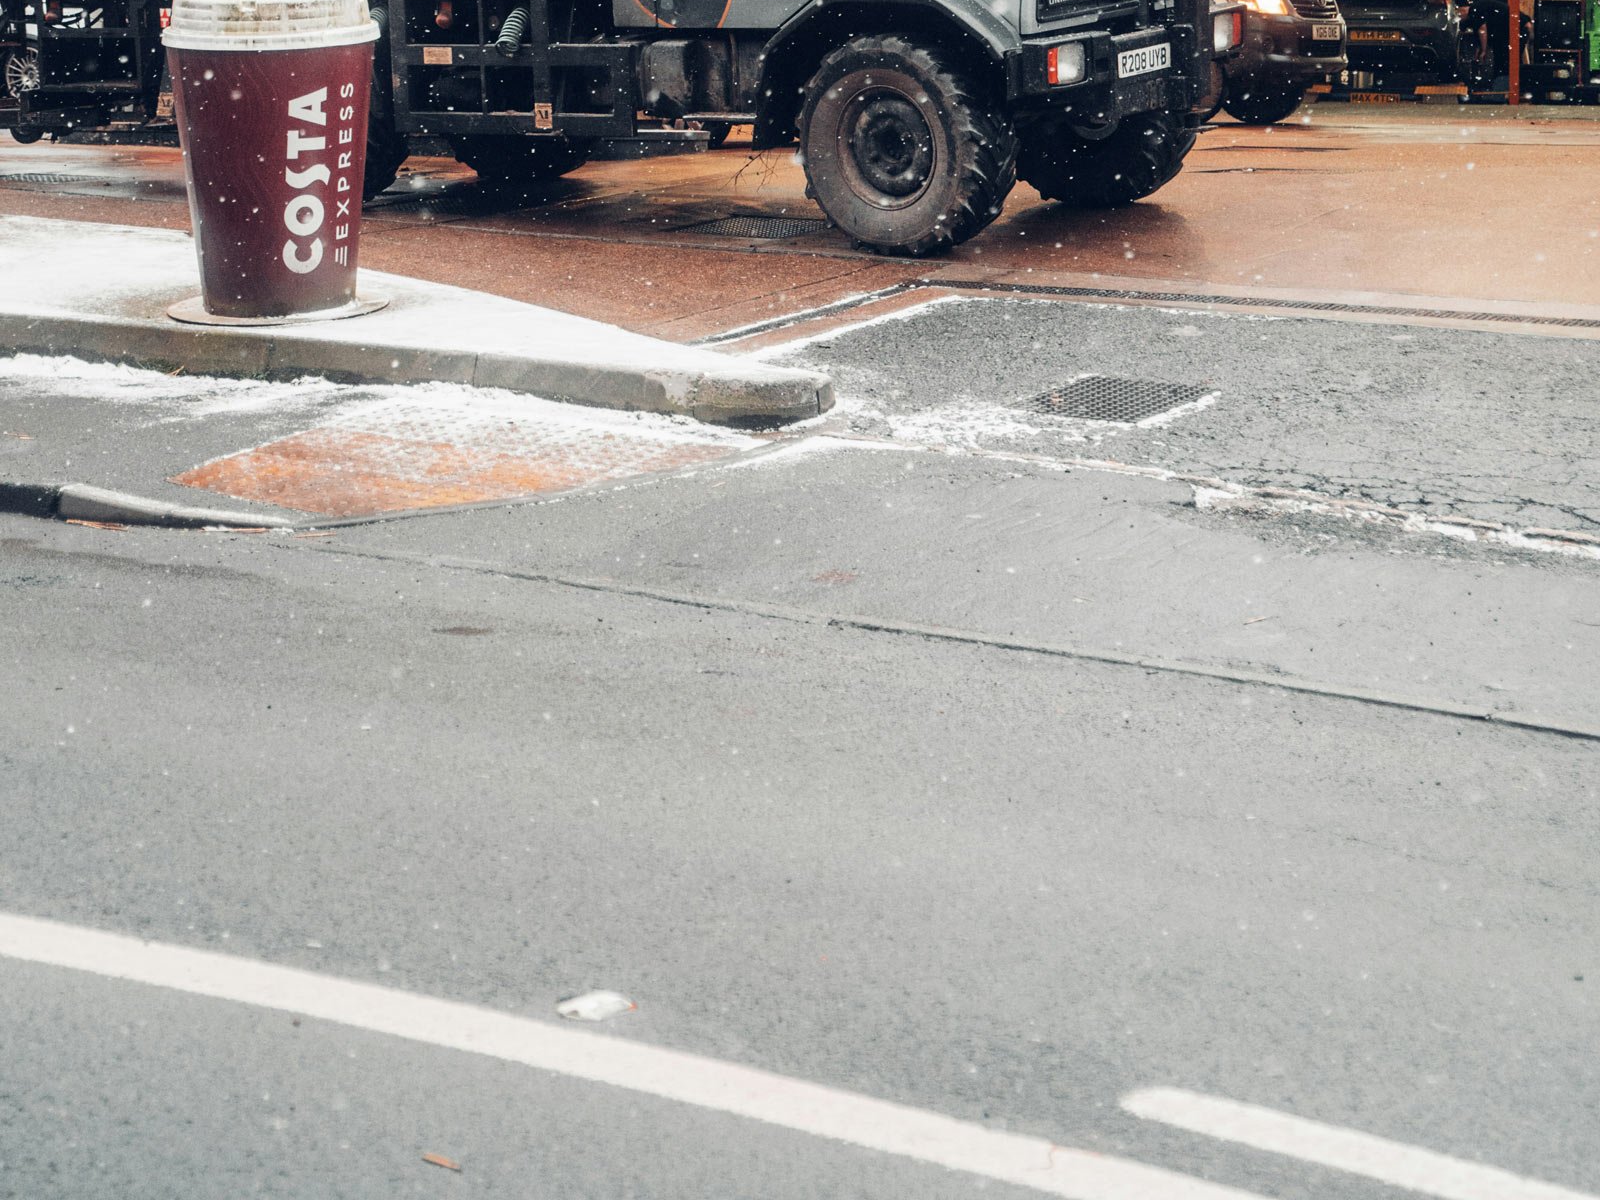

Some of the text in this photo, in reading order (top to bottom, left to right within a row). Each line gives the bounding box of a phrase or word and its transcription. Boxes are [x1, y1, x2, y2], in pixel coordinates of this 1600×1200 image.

[1121, 46, 1167, 74] R208 UYB
[283, 86, 331, 274] COSTA
[336, 82, 354, 240] EXPRESS
